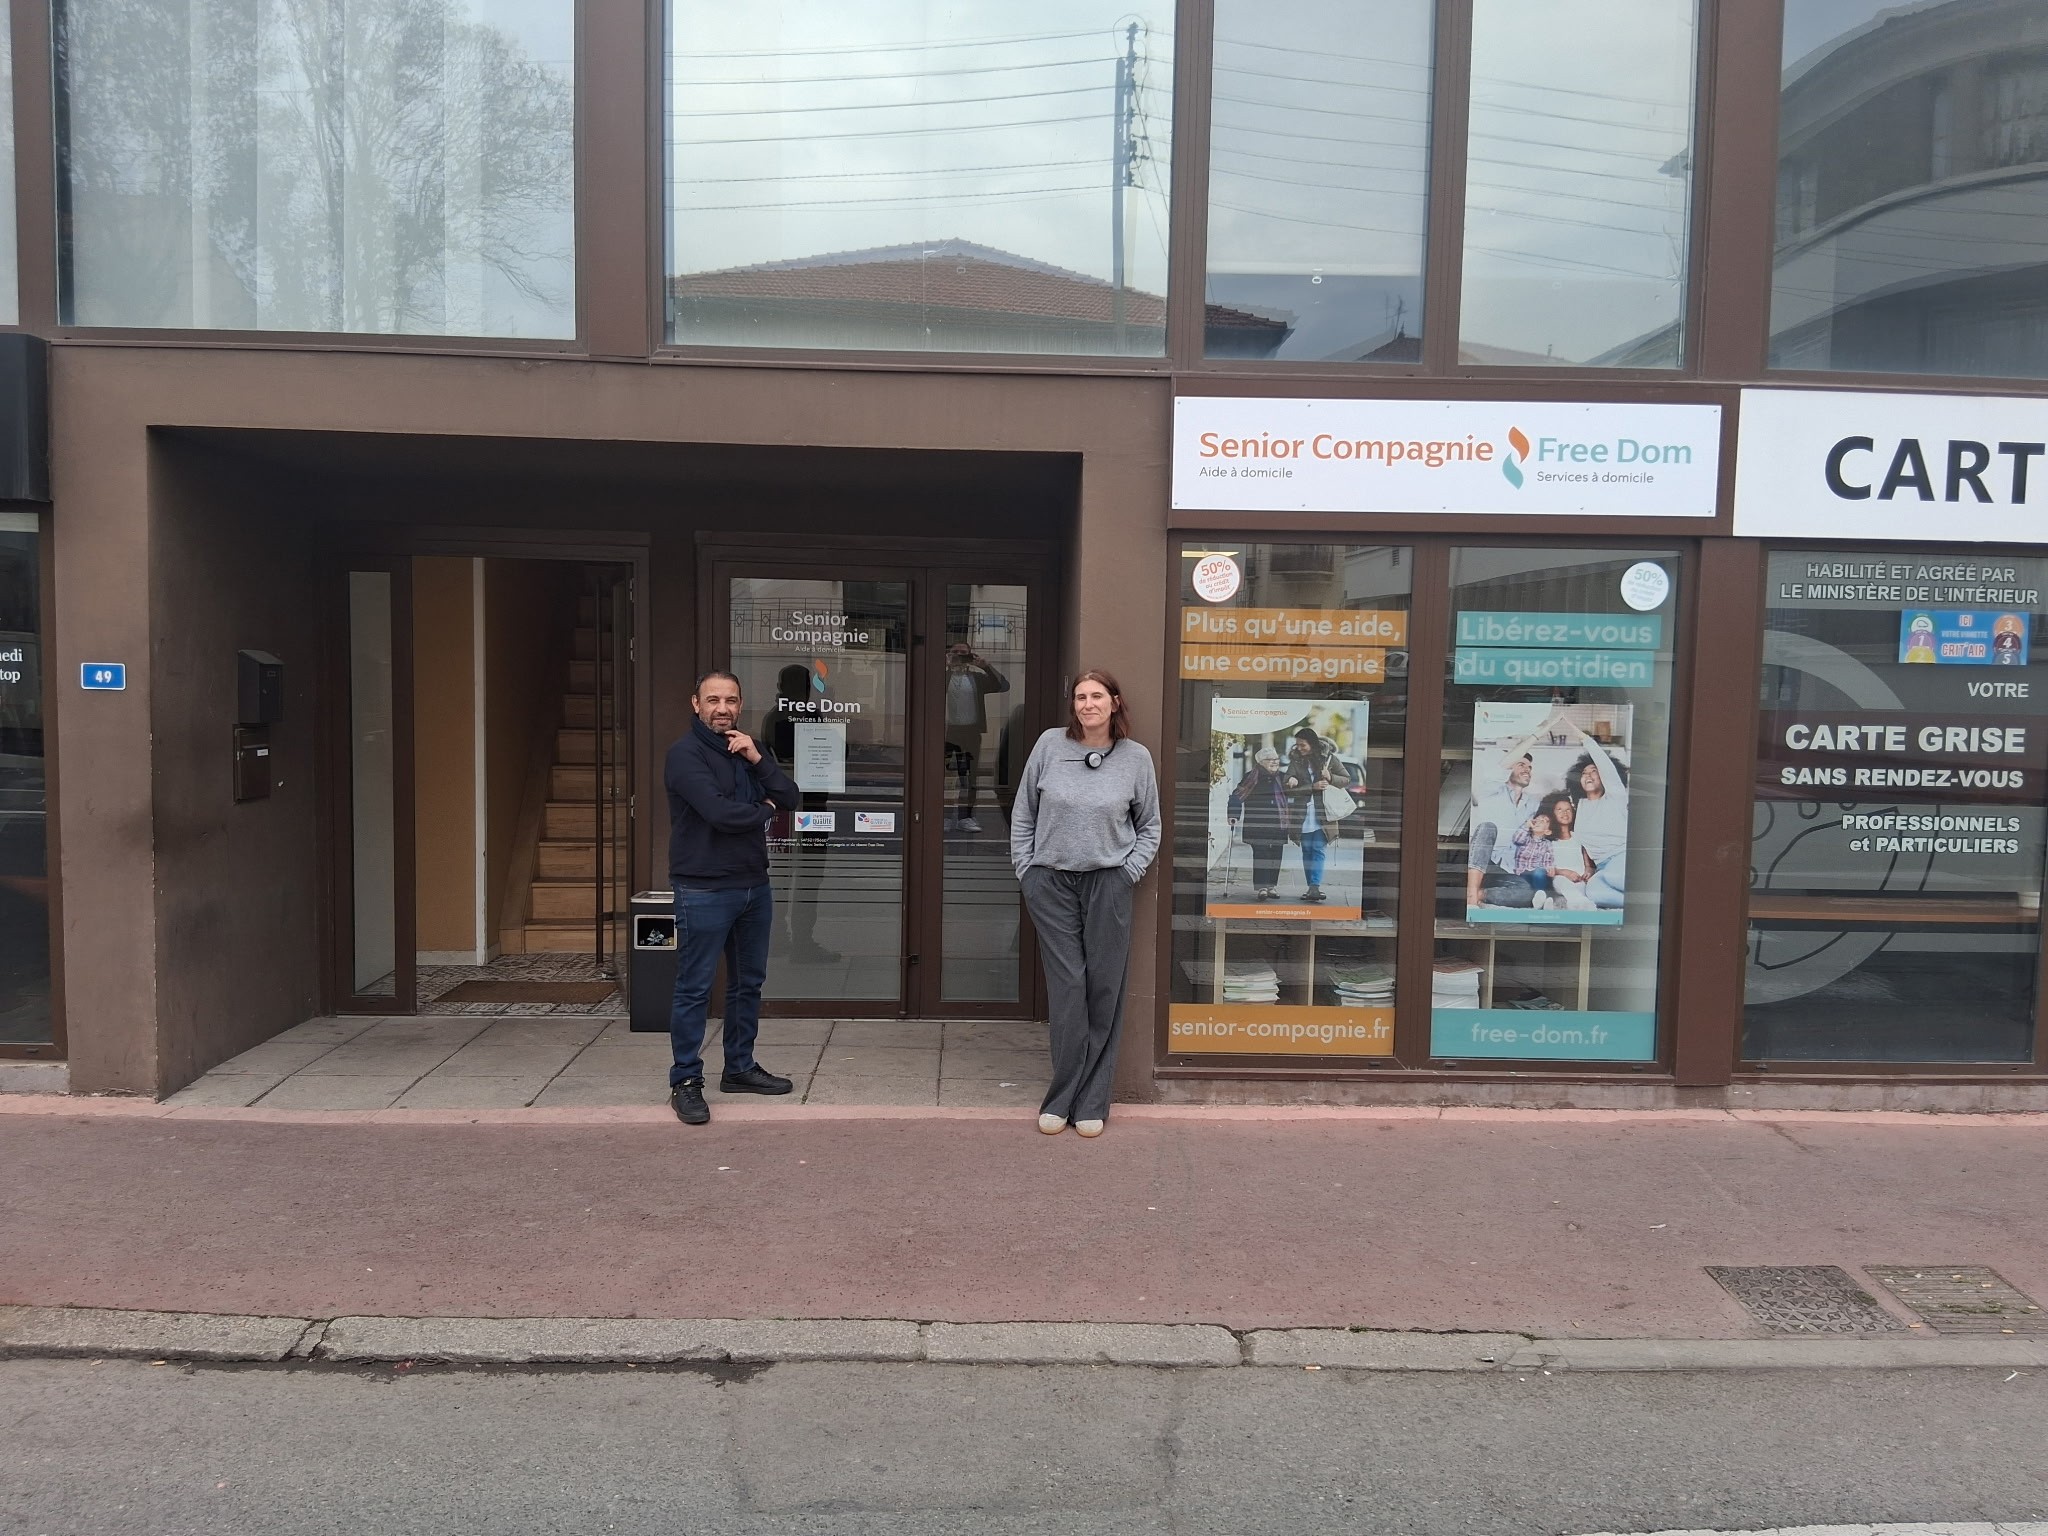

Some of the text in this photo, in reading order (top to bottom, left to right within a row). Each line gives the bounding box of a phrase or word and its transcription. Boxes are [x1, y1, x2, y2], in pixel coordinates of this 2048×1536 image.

[1199, 432, 1494, 468] Senior Compagnie
[1537, 437, 1692, 465] Free Dom
[1199, 466, 1293, 480] Aide à domicile
[1536, 470, 1655, 485] Services à domicile
[1824, 435, 2046, 505] CART
[1200, 559, 1231, 577] 50%
[1634, 568, 1663, 586] 50%
[1807, 561, 2016, 582] HABILITÉ ET AGRÉÉ PAR
[1781, 582, 2039, 604] LE MINISTÈRE DE L'INTÉRIEUR
[792, 611, 849, 626] Senior
[1185, 612, 1402, 642] Plus qu'une aide,
[1959, 614, 1973, 627] ICI
[2004, 620, 2013, 631] 3
[772, 627, 869, 646] Compagnie
[1461, 617, 1653, 645] Libérez-vous
[1919, 635, 1926, 646] 1
[2003, 637, 2012, 648] 4
[1184, 650, 1379, 680] une compagnie
[1463, 652, 1646, 682] du quotidien
[2002, 653, 2011, 664] 5
[95, 670, 112, 683] 49
[1967, 682, 2029, 698] VOTRE
[778, 697, 861, 713] Free Dom
[1227, 707, 1288, 718] Senior Compagnie
[787, 715, 816, 724] Services
[822, 716, 851, 724] domicile
[1785, 724, 2026, 753] CARTE GRISE
[1781, 768, 2024, 788] SANS RENDEZ-VOUS
[1842, 814, 2021, 832] PROFESSIONNELS
[1850, 837, 2019, 854] et PARTICULIERS
[1171, 1016, 1391, 1043] senior-compagnie.fr
[1471, 1022, 1609, 1047] free-dom.fr
